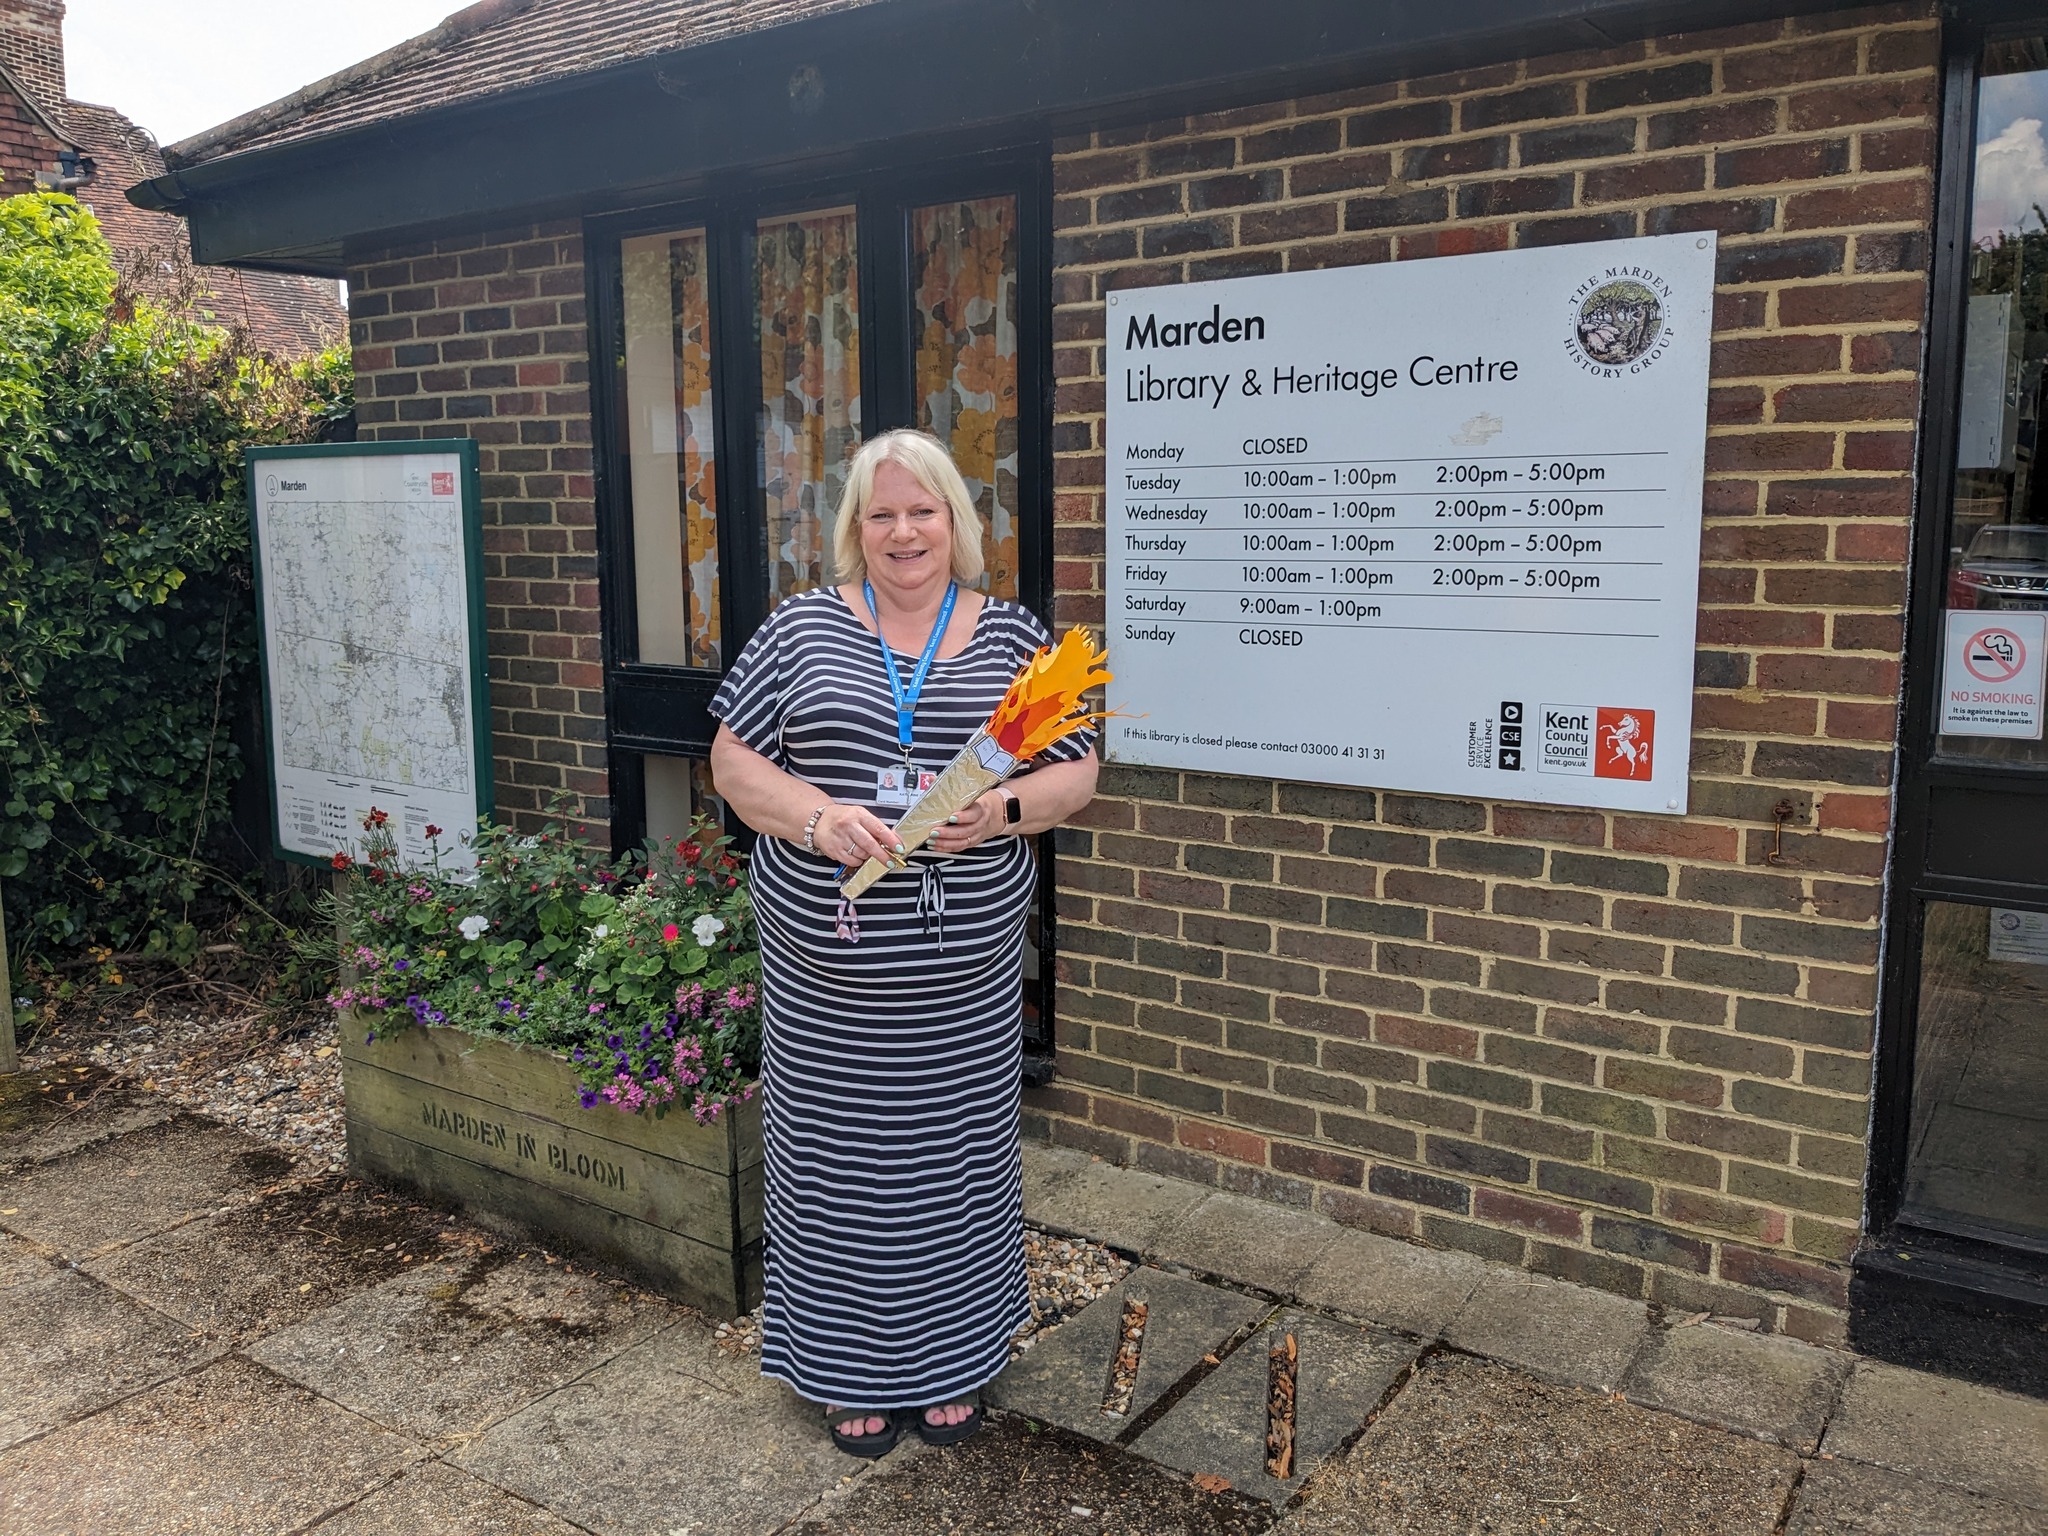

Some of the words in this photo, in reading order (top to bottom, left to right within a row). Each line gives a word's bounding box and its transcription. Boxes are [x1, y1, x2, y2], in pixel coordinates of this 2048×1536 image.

[1569, 275, 1599, 306] THE
[1605, 266, 1672, 298] MARDEN
[1125, 303, 1265, 351] Marden
[1564, 338, 1623, 378] HISTORY
[1630, 327, 1674, 374] GROUP
[1124, 364, 1231, 410] Library
[1241, 368, 1262, 397] &
[1273, 363, 1398, 398] Heritage
[1409, 355, 1519, 387] Centre
[1126, 441, 1185, 463] Monday
[1242, 437, 1308, 456] CLOSED
[280, 480, 307, 491] Marden
[1125, 472, 1181, 494] Tuesday
[1244, 470, 1313, 487] 10:00am
[1333, 467, 1396, 490] 1:00pm
[1436, 464, 1508, 488] 2:00pm
[1528, 462, 1605, 486] 5:00pm
[1125, 503, 1208, 525] Wednesday
[1243, 502, 1313, 519] 10:00am
[1332, 501, 1395, 523] 1:00pm
[1435, 499, 1507, 523] 2:00pm
[1527, 498, 1604, 522] 5:00pm
[1124, 534, 1187, 556] Thursday
[1243, 534, 1312, 551] 10:00am
[1331, 534, 1394, 556] 1:00pm
[1434, 534, 1505, 557] 2:00pm
[1525, 533, 1602, 558] 5:00pm
[1125, 564, 1168, 586] Friday
[1242, 566, 1311, 583] 10:00am
[1331, 567, 1393, 589] 1:00pm
[1432, 568, 1504, 591] 2:00pm
[1524, 569, 1600, 593] 5:00pm
[1125, 594, 1187, 616] Saturday
[1240, 597, 1300, 615] 9:00am
[1319, 599, 1381, 622] 1:00pm
[1125, 624, 1176, 646] Sunday
[1239, 628, 1303, 647] CLOSED
[1951, 691, 1969, 702] NO
[1972, 692, 2036, 705] SMOKING.
[1967, 707, 1993, 716] against
[1546, 711, 1588, 731] Kent
[2001, 717, 2033, 725] premises
[1123, 728, 1130, 738] If
[1132, 728, 1147, 740] this
[1149, 729, 1180, 745] library
[1183, 733, 1190, 743] is
[1192, 733, 1222, 747] closed
[1226, 736, 1258, 750] please
[1260, 742, 1298, 753] contact
[1301, 742, 1338, 756] 03000
[1341, 746, 1353, 757] 41
[1357, 747, 1369, 759] 31
[1373, 748, 1385, 760] 31
[1468, 721, 1477, 768] CUSTOMER
[1483, 718, 1493, 769] EXCELLENCE
[1501, 731, 1520, 741] CSE
[1545, 729, 1588, 745] County
[1475, 736, 1484, 768] SERVICE
[1544, 743, 1588, 757] Council
[1544, 757, 1587, 768] kent.gov.uk
[422, 1101, 507, 1151] MARDEN
[516, 1132, 537, 1162] IN
[547, 1143, 626, 1192] BLOOM
